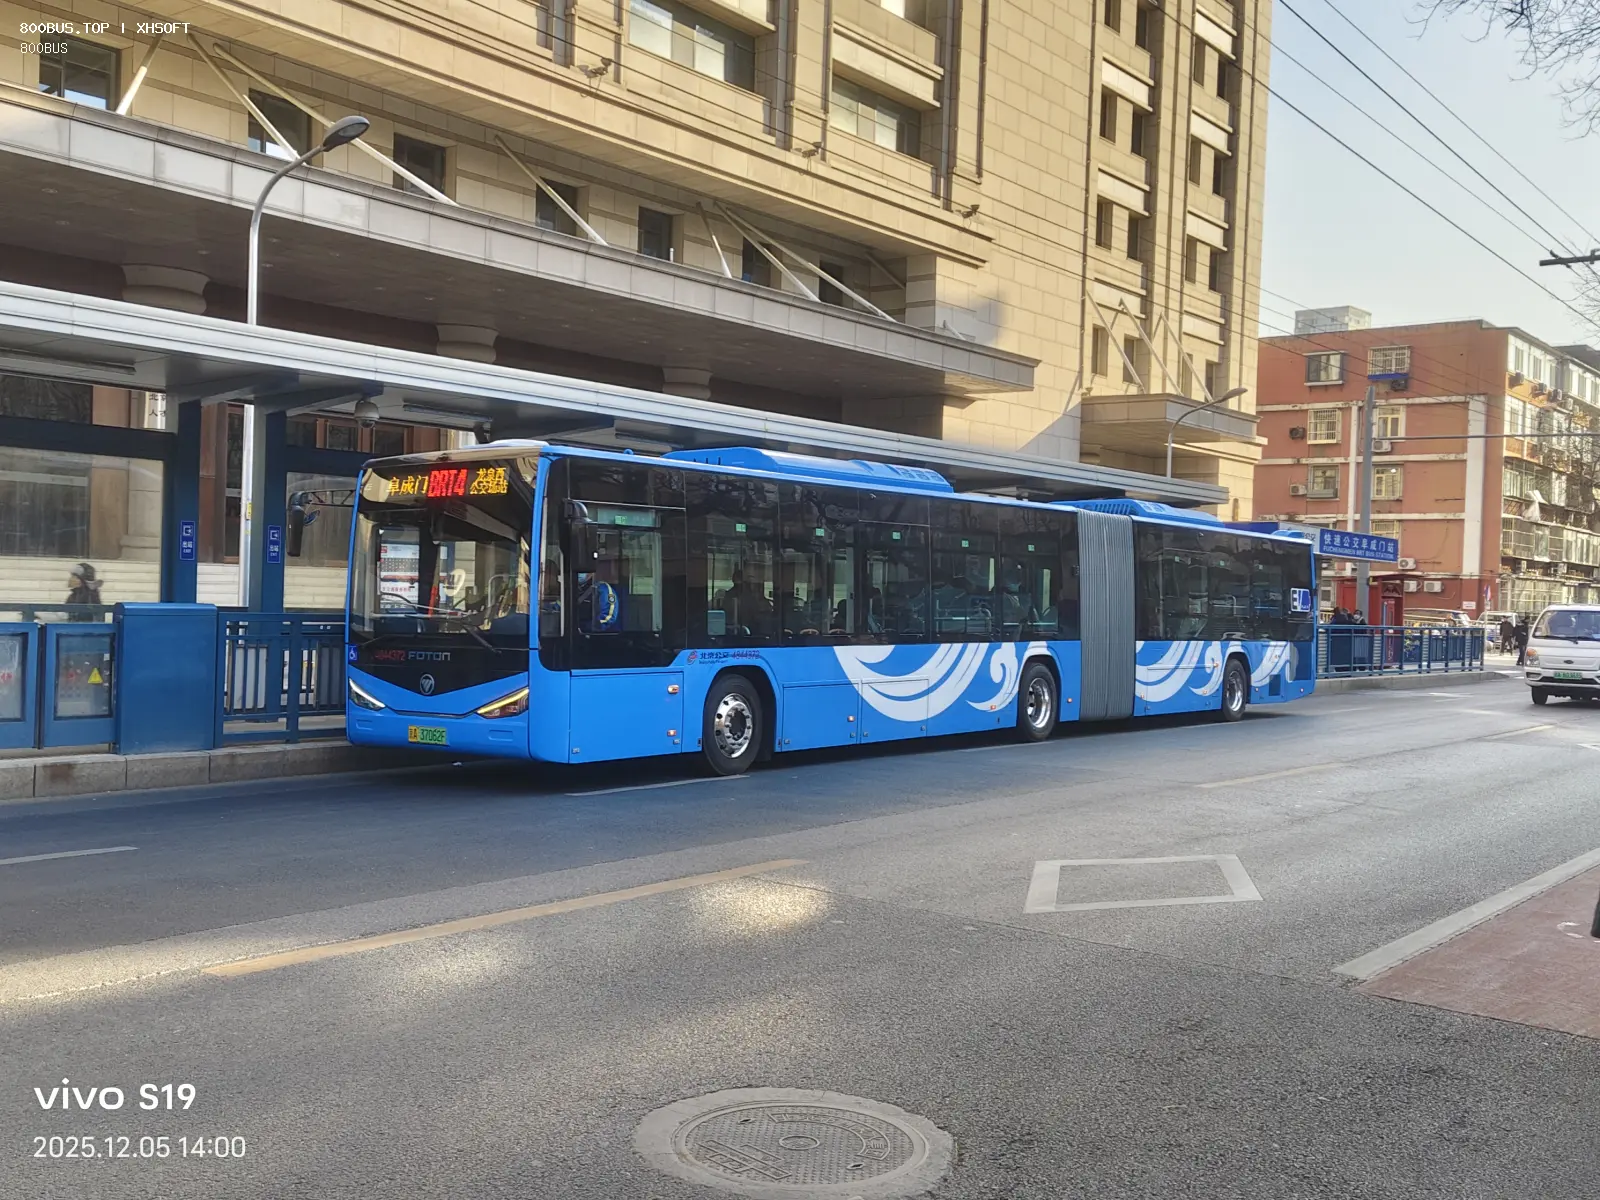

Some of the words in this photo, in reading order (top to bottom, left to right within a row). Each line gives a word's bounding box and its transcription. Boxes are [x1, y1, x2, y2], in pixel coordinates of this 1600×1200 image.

[427, 469, 468, 497] BRT4
[476, 467, 506, 481] 龙泉西
[388, 475, 429, 496] 阜成门
[1323, 532, 1395, 553] 快速公交阜成门站
[408, 651, 451, 661] FOTON
